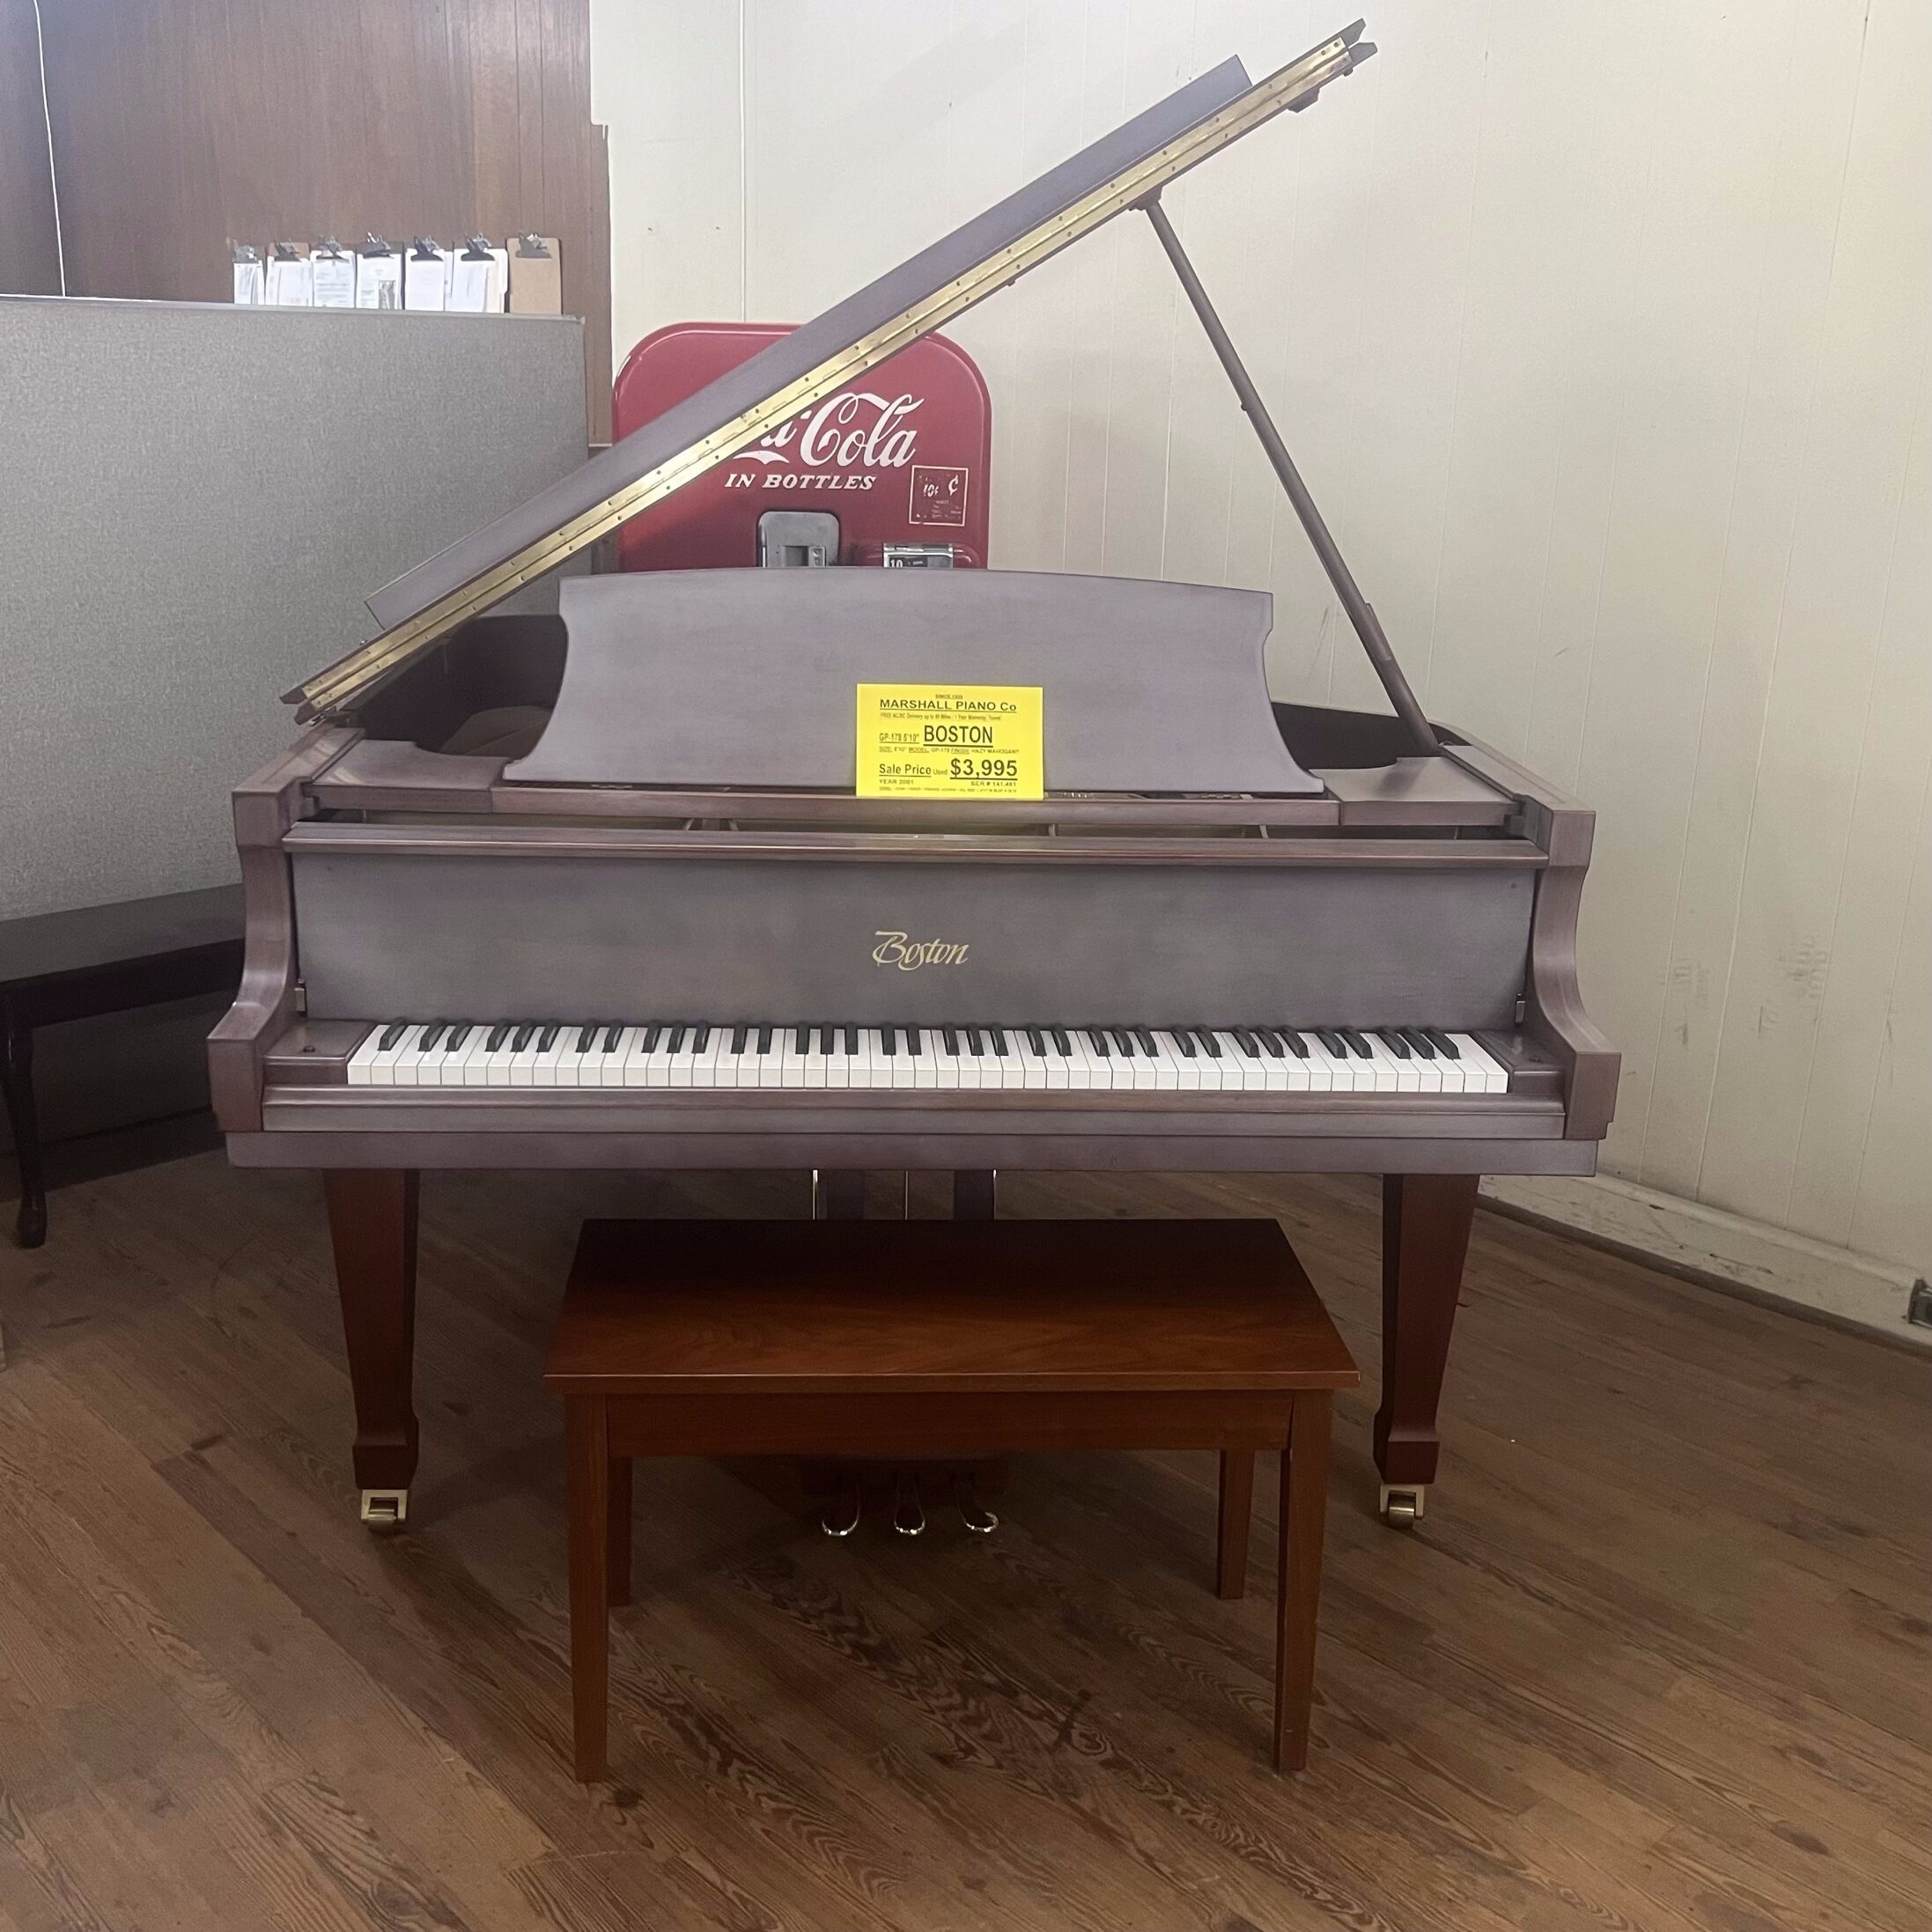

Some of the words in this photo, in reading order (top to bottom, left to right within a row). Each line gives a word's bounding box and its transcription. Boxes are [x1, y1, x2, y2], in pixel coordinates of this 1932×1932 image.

[724, 473, 756, 488] IN
[762, 474, 876, 490] BOTTLES
[880, 699, 952, 710] MARSHALL
[956, 701, 996, 711] PIANO
[1000, 702, 1017, 712] Co
[879, 733, 902, 741] GP-178
[924, 725, 992, 743] BOSTON
[879, 763, 902, 774] Sale
[904, 763, 932, 775] Price
[950, 757, 1018, 778] $3,995
[872, 930, 970, 971] Boston
